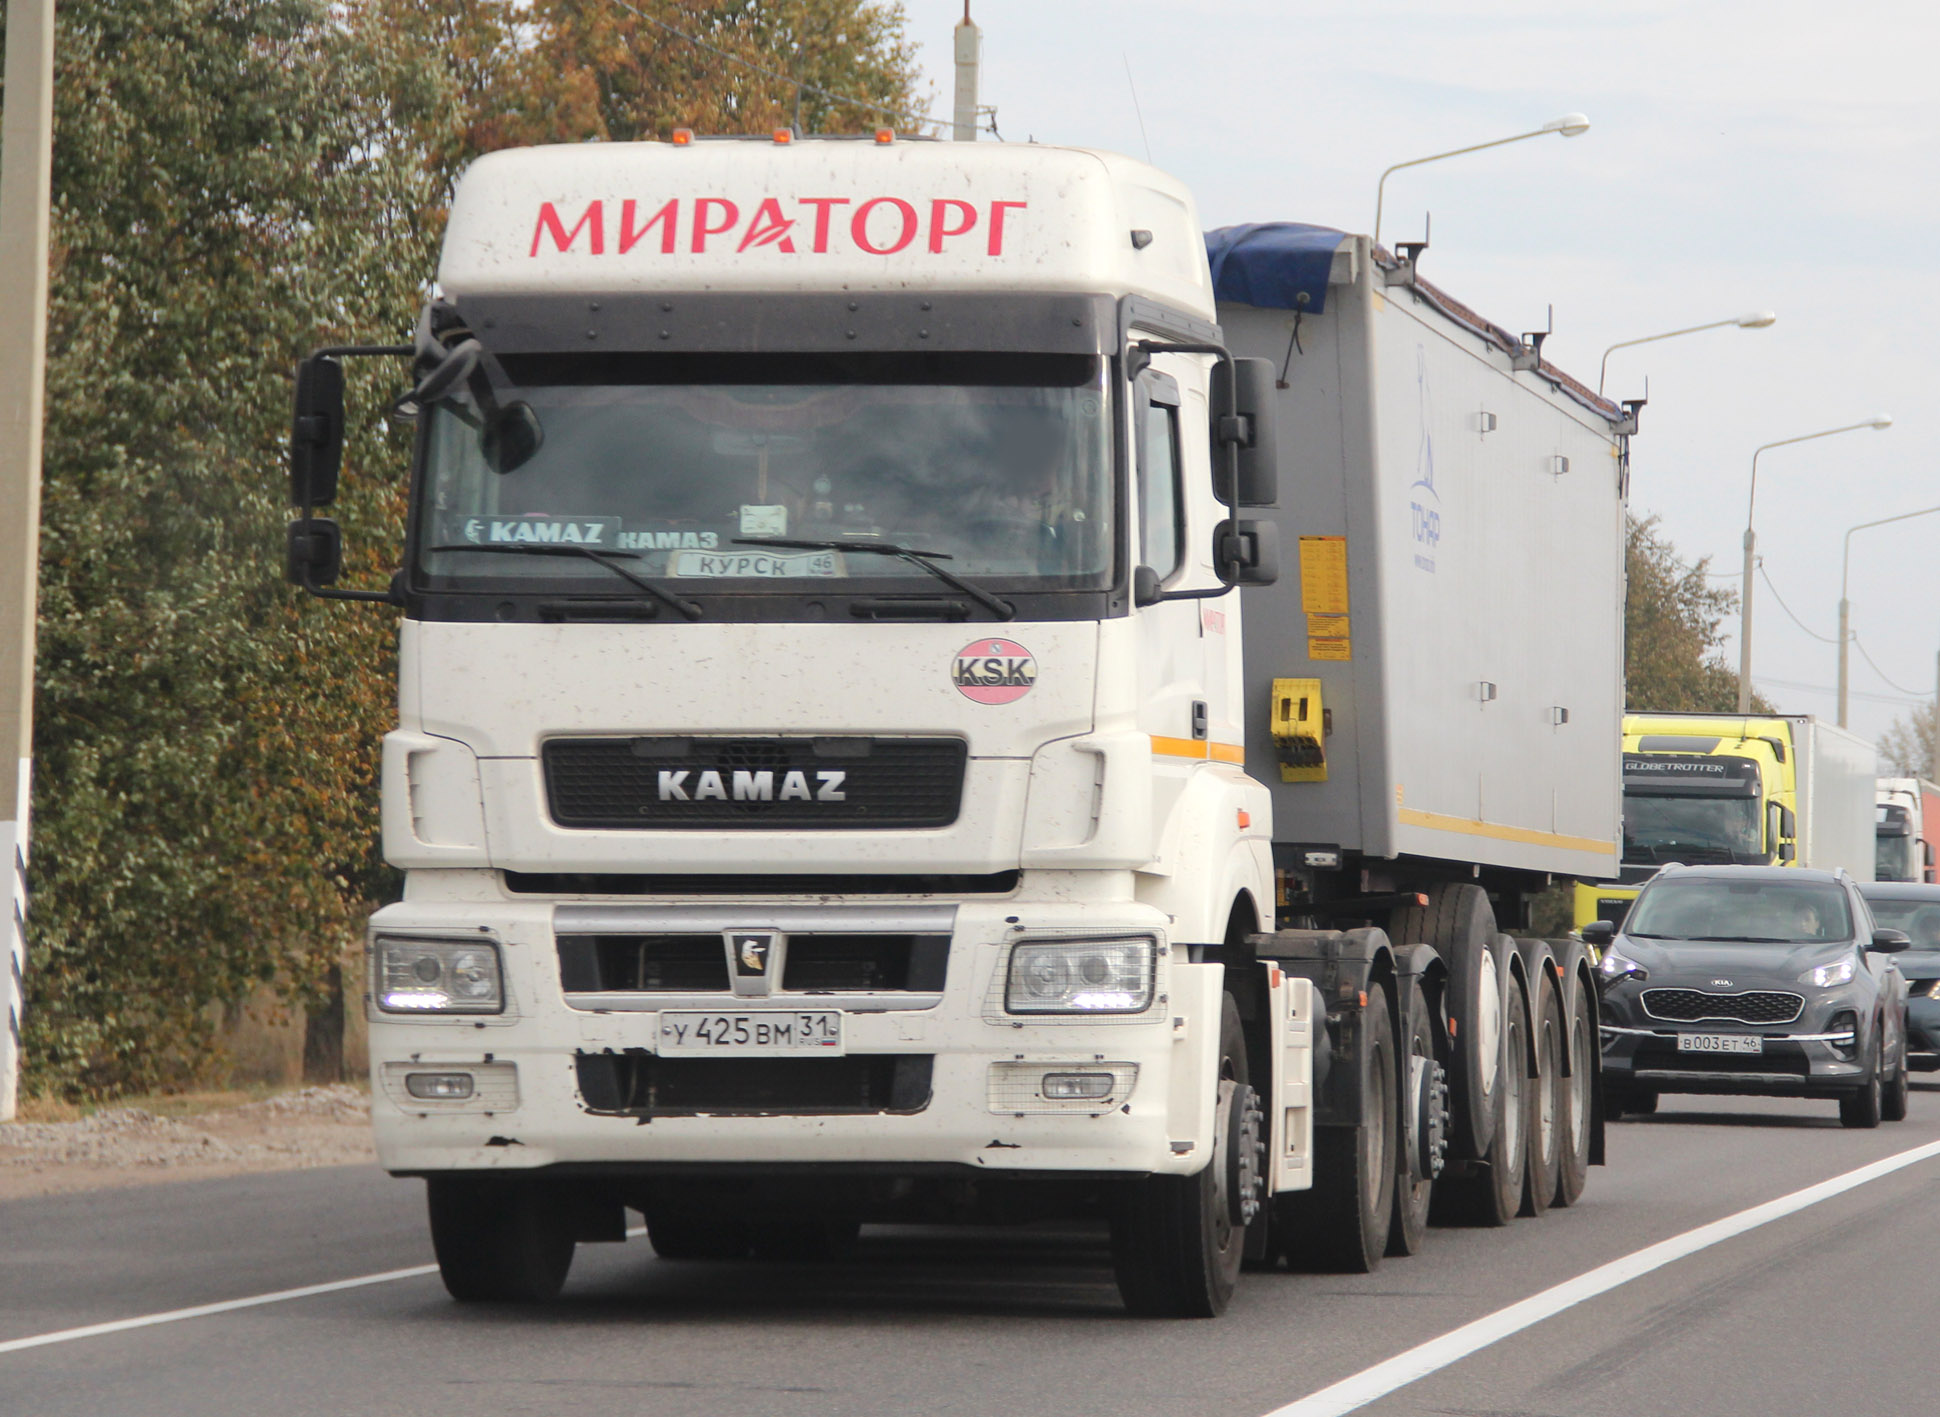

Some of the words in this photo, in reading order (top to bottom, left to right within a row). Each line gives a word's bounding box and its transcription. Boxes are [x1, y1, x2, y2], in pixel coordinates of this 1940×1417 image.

[530, 197, 1027, 257] МИРАТОРГ
[490, 521, 605, 543] KAMAZ
[700, 556, 787, 576] КУРСК
[812, 556, 833, 569] 46
[958, 658, 1033, 686] KSK
[1625, 762, 1724, 773] GLOBETROTTER
[658, 771, 847, 801] KAMAZ
[1713, 979, 1731, 987] KIA
[800, 1015, 828, 1037] 31
[1743, 1037, 1757, 1047] 46
